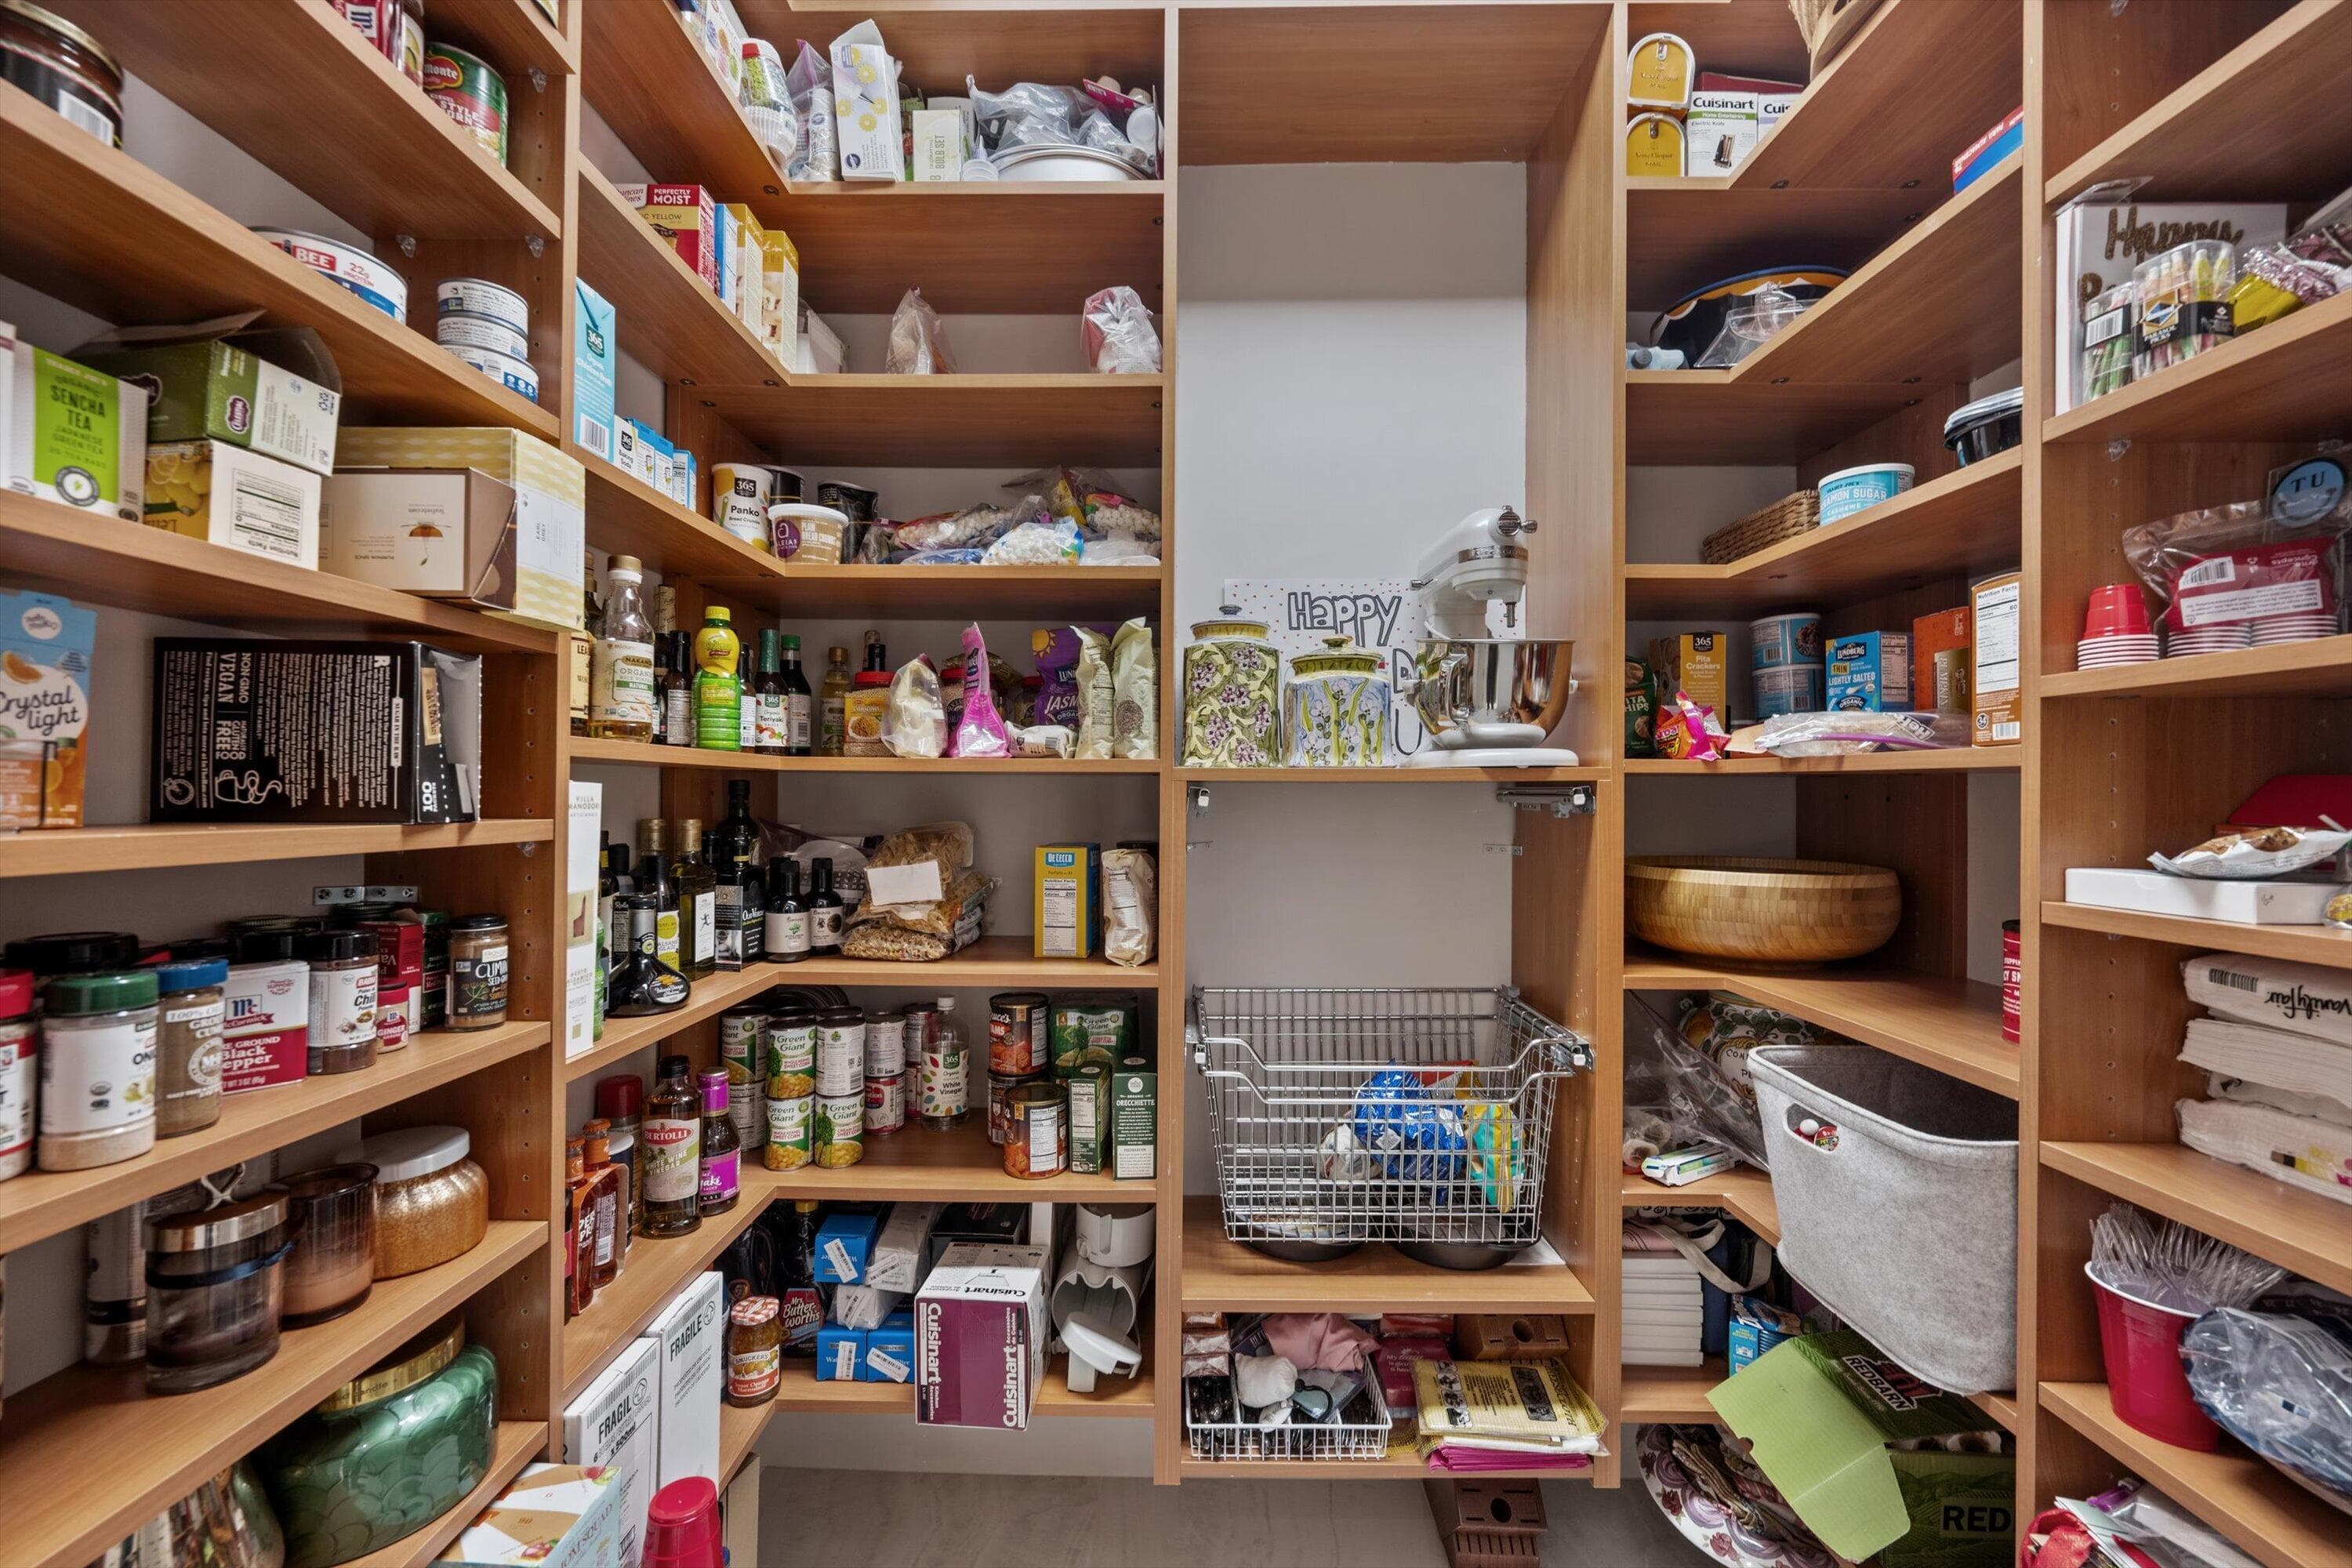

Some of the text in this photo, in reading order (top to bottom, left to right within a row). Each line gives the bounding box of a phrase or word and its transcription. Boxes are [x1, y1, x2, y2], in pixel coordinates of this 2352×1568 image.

[1693, 96, 1754, 110] Cuisinart
[935, 135, 945, 169] BULB SET
[653, 195, 691, 205] MOIST
[295, 245, 332, 267] BEE
[587, 328, 604, 350] 365
[50, 384, 106, 418] SENCHA
[67, 409, 92, 432] TEA
[621, 432, 633, 445] 365
[736, 480, 754, 491] 365
[1853, 488, 1886, 500] SUGAR
[730, 505, 760, 517] Panko
[1977, 585, 2018, 601] Nutrition Facts
[1287, 591, 1402, 648] Happy
[1694, 637, 1711, 647] 365
[1837, 645, 1865, 659] LUNDBERG
[1833, 662, 1847, 673] THIN
[216, 653, 236, 703] VEGAN
[1828, 672, 1875, 686] LIGHTLY SALTED
[1626, 695, 1646, 705] ITA
[1839, 698, 1864, 708] ORGANIC
[27, 708, 81, 737] light
[759, 715, 784, 724] Teriyaki
[216, 720, 231, 750] FREE
[230, 720, 241, 750] GLUTEN
[423, 781, 433, 813] 100
[2297, 985, 2352, 1019] vanity
[223, 1014, 268, 1029] cCormick
[378, 1025, 405, 1036] GINGER
[990, 1025, 1005, 1036] AMS
[235, 1036, 281, 1048] GROUND
[776, 1035, 805, 1044] Green
[223, 1046, 267, 1059] Black
[779, 1043, 806, 1052] Giant
[223, 1054, 273, 1070] epper
[768, 1105, 795, 1113] Green
[829, 1103, 857, 1112] Green
[770, 1113, 795, 1122] Giant
[833, 1110, 858, 1120] Giant
[644, 1130, 688, 1141] BERTOLLI
[667, 1149, 688, 1163] WINE
[649, 1160, 681, 1176] VINEGAR
[964, 1287, 1026, 1298] Cuisinart
[670, 1314, 702, 1362] FRAGILE
[928, 1302, 942, 1383] Cuisinart
[735, 1352, 770, 1366] SMUCKER'S
[1003, 1345, 1018, 1427] Cuisinart
[1845, 1356, 1913, 1410] REDBARN
[598, 1395, 633, 1444] FRAGIL
[615, 1421, 637, 1449] 500ml
